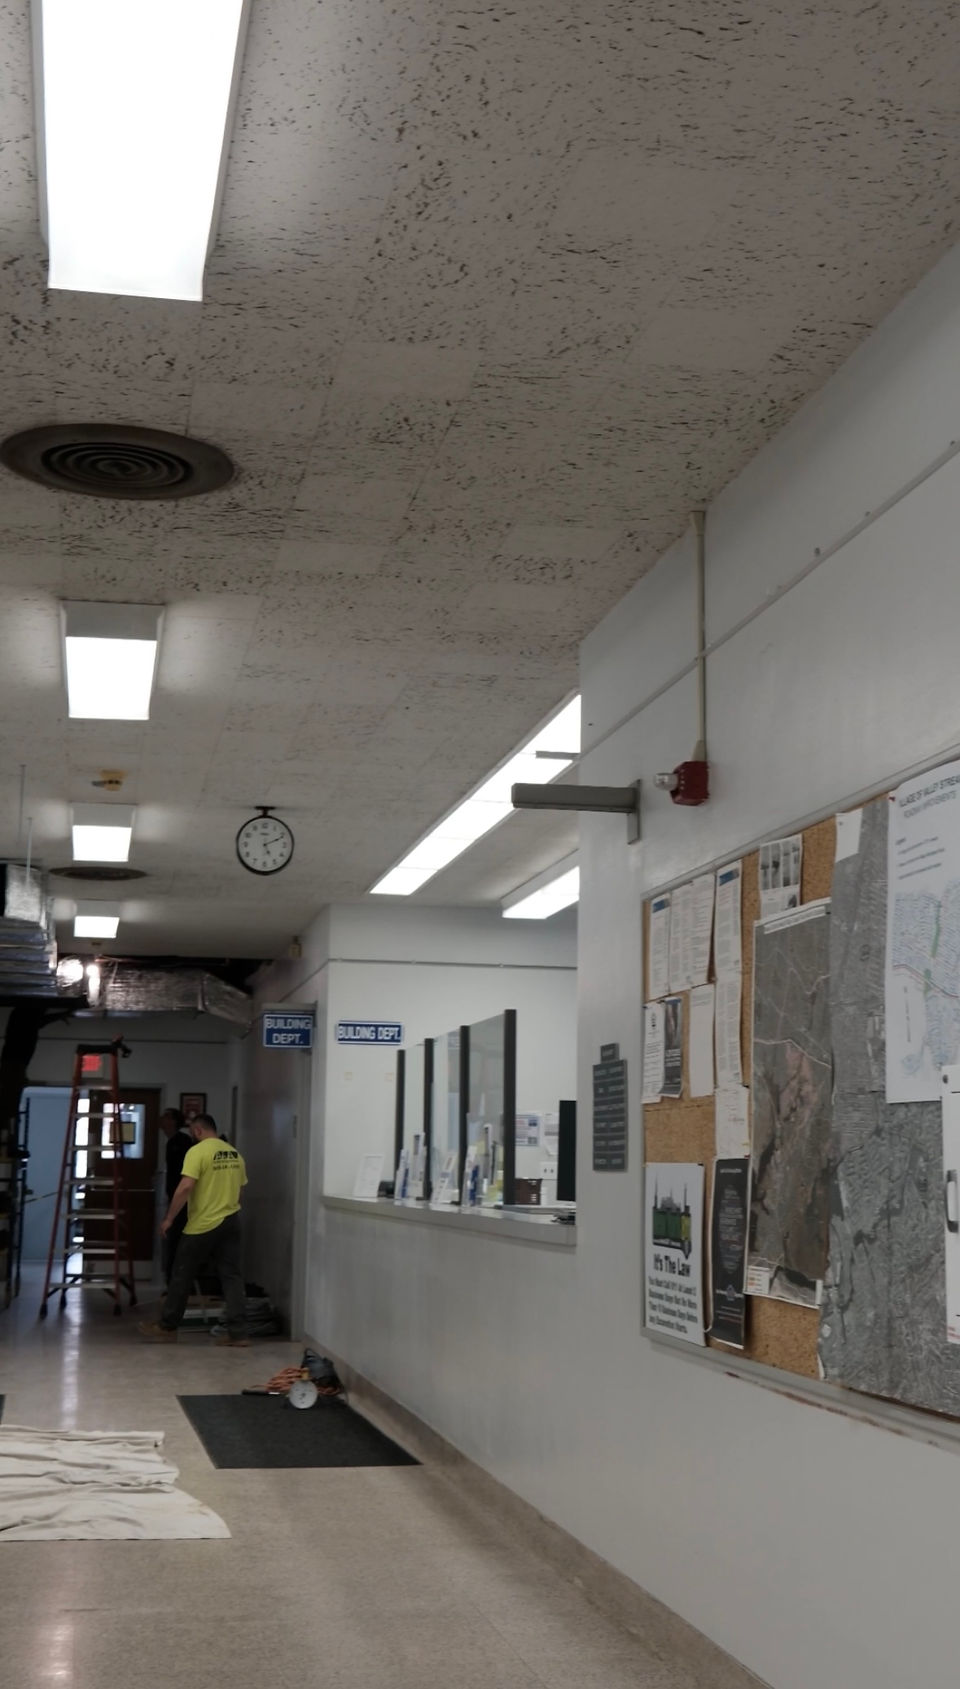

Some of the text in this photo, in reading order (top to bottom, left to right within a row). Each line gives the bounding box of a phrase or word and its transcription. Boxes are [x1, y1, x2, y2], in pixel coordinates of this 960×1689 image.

[266, 1018, 311, 1029] BUILDING
[272, 1033, 303, 1044] DEPT.
[338, 1026, 400, 1040] BUILDING DEPT.
[653, 1253, 691, 1277] It's The Law
